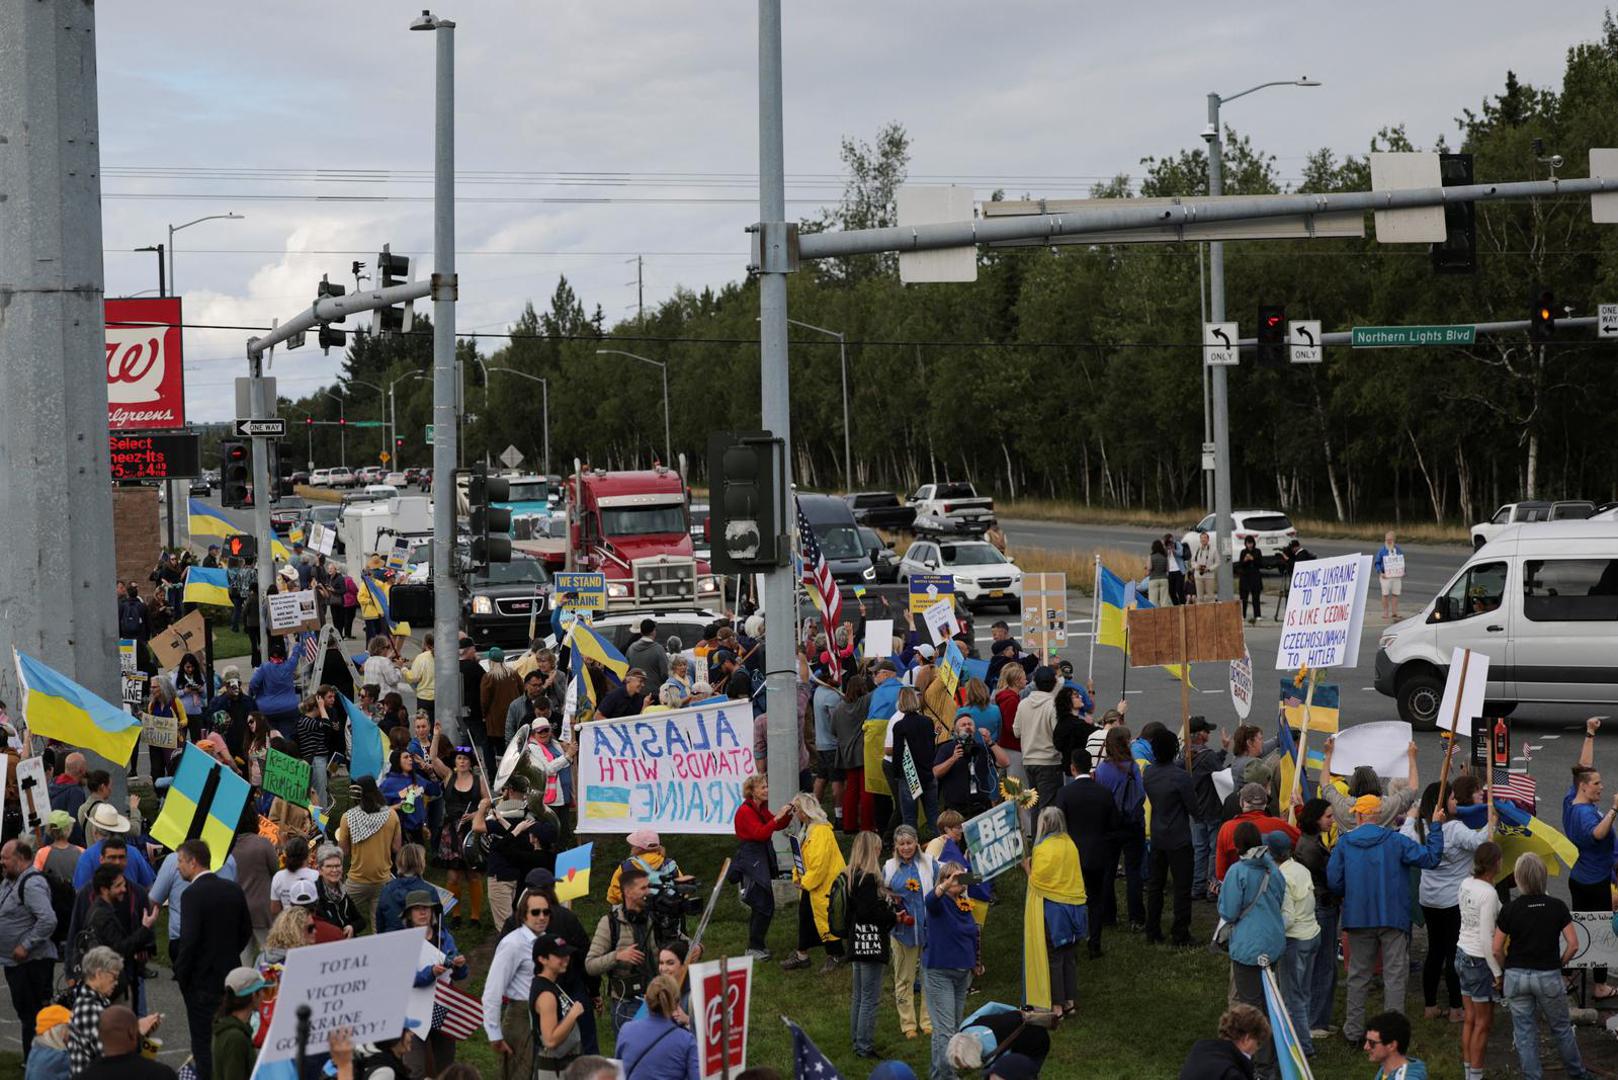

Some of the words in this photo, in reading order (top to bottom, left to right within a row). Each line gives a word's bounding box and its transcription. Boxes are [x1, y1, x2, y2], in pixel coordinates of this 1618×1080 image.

[1602, 306, 1618, 314] ONE
[1602, 315, 1618, 323] WAY
[1358, 332, 1405, 343] Northern
[1409, 331, 1442, 345] Lights
[1446, 330, 1470, 341] Blvd
[1210, 352, 1233, 362] ONLY
[1295, 350, 1317, 360] ONLY
[559, 576, 572, 588] WE
[573, 576, 602, 588] STAND
[1293, 568, 1321, 588] CEDING
[1322, 562, 1356, 586] UKRAINE
[1303, 588, 1312, 605] TO
[1320, 584, 1348, 605] PUTIN
[1287, 609, 1296, 626] IS
[1299, 607, 1320, 626] LIKE
[1324, 603, 1350, 624] CEDING
[1283, 629, 1346, 650] CZECHOSLOVAKIA
[1288, 652, 1299, 667] TO
[1307, 647, 1335, 666] HITLER
[978, 809, 1011, 846] BE
[975, 829, 1023, 876] KIND
[855, 923, 878, 932] NEW
[854, 941, 881, 950] FILM
[855, 933, 880, 941] YORK
[320, 954, 369, 975] TOTAL
[306, 978, 370, 1000] VICTORY
[323, 999, 343, 1014] TO
[309, 1010, 362, 1032] KRAINE
